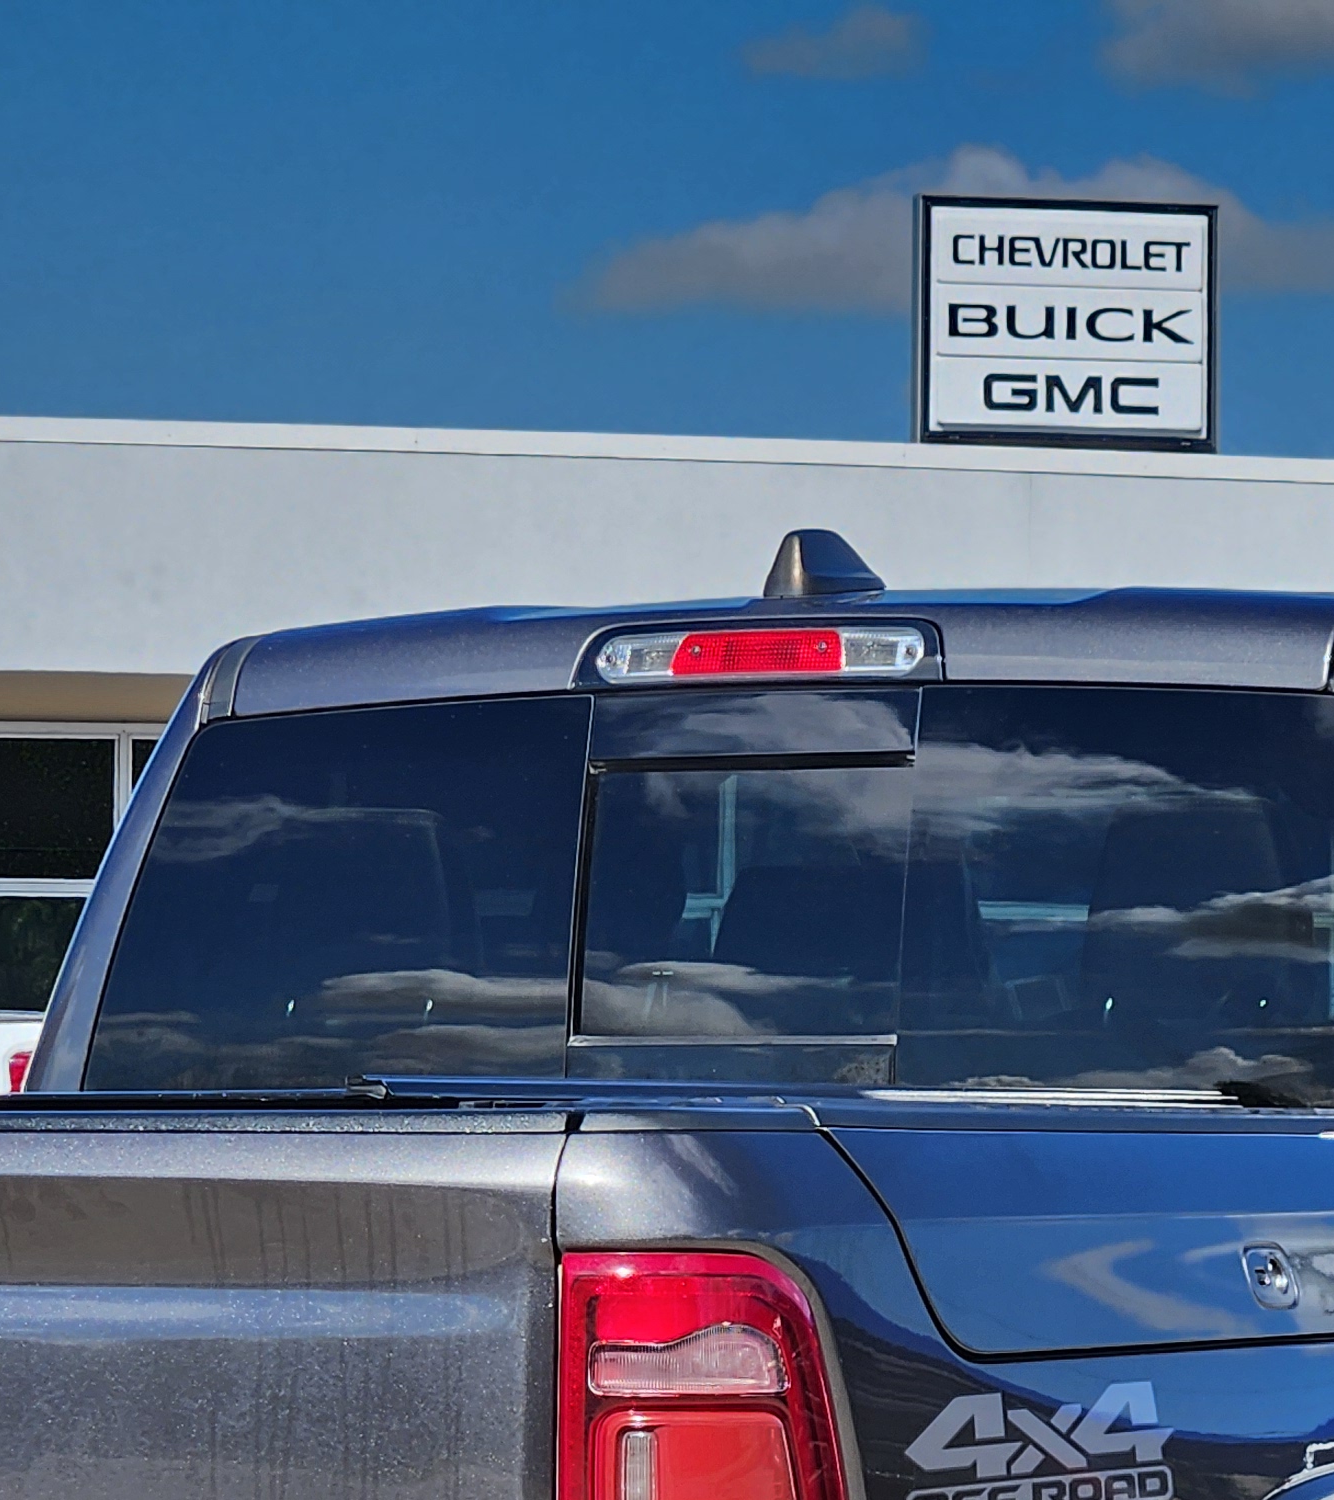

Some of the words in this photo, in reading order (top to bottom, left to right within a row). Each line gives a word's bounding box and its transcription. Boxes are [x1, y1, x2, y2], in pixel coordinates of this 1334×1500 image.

[952, 234, 1191, 272] CHEVROLET
[947, 303, 1195, 344] BUICK
[982, 373, 1160, 416] GMC
